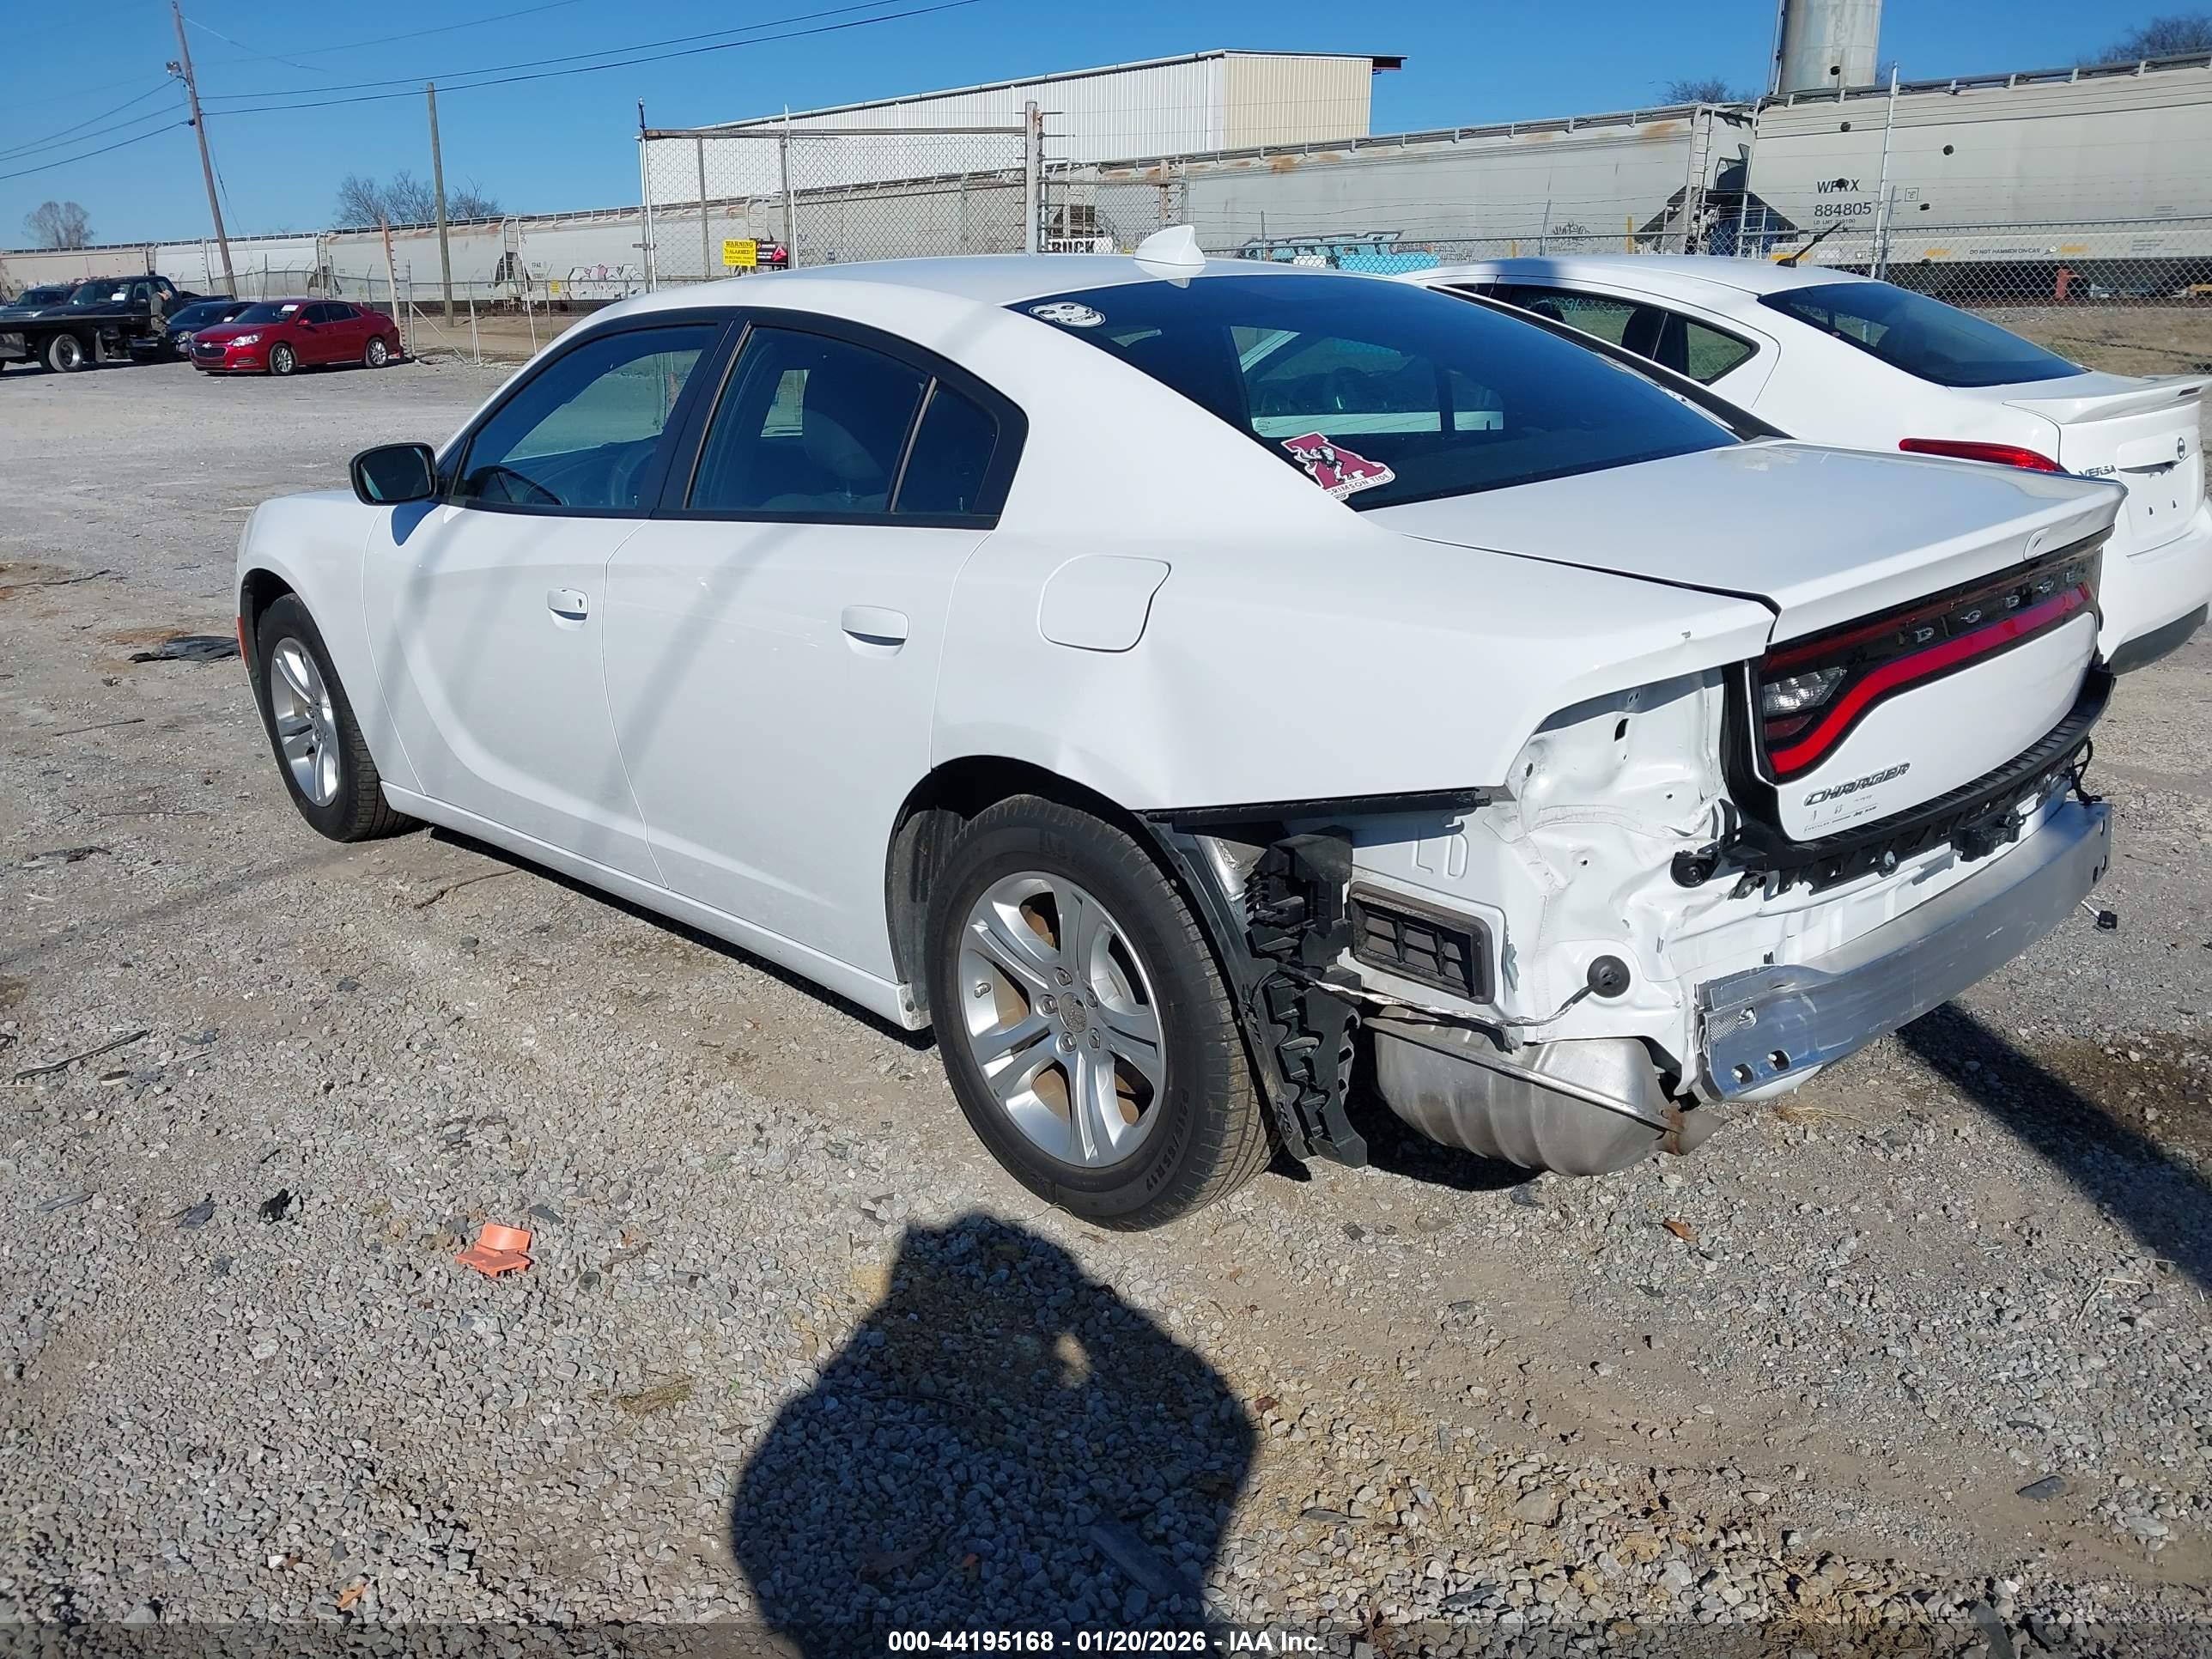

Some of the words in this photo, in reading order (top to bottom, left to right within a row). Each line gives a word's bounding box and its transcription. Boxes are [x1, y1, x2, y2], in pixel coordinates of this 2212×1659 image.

[1814, 203, 1872, 216] 884805
[1048, 240, 1096, 253] RUCK
[1370, 473, 1391, 484] TIDE
[1915, 570, 2076, 642] DODGE
[1804, 763, 1911, 806] CHARGER
